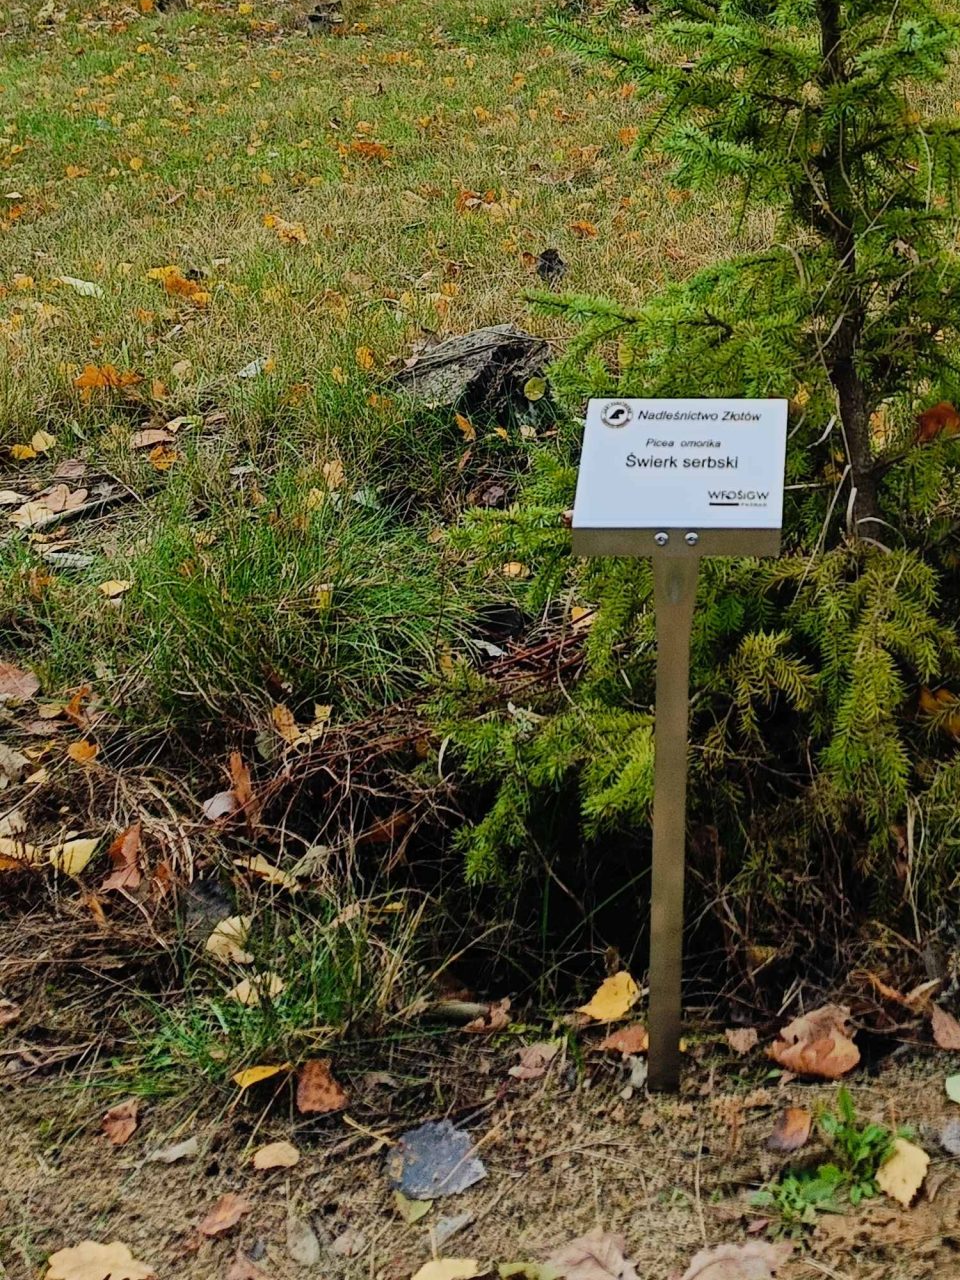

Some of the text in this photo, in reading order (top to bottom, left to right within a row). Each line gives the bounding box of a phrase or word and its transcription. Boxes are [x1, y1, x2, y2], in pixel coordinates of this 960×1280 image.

[638, 410, 762, 421] Nadleśnictwo Złotów
[646, 438, 721, 448] Picea omorika
[625, 452, 738, 468] Świerk serbski
